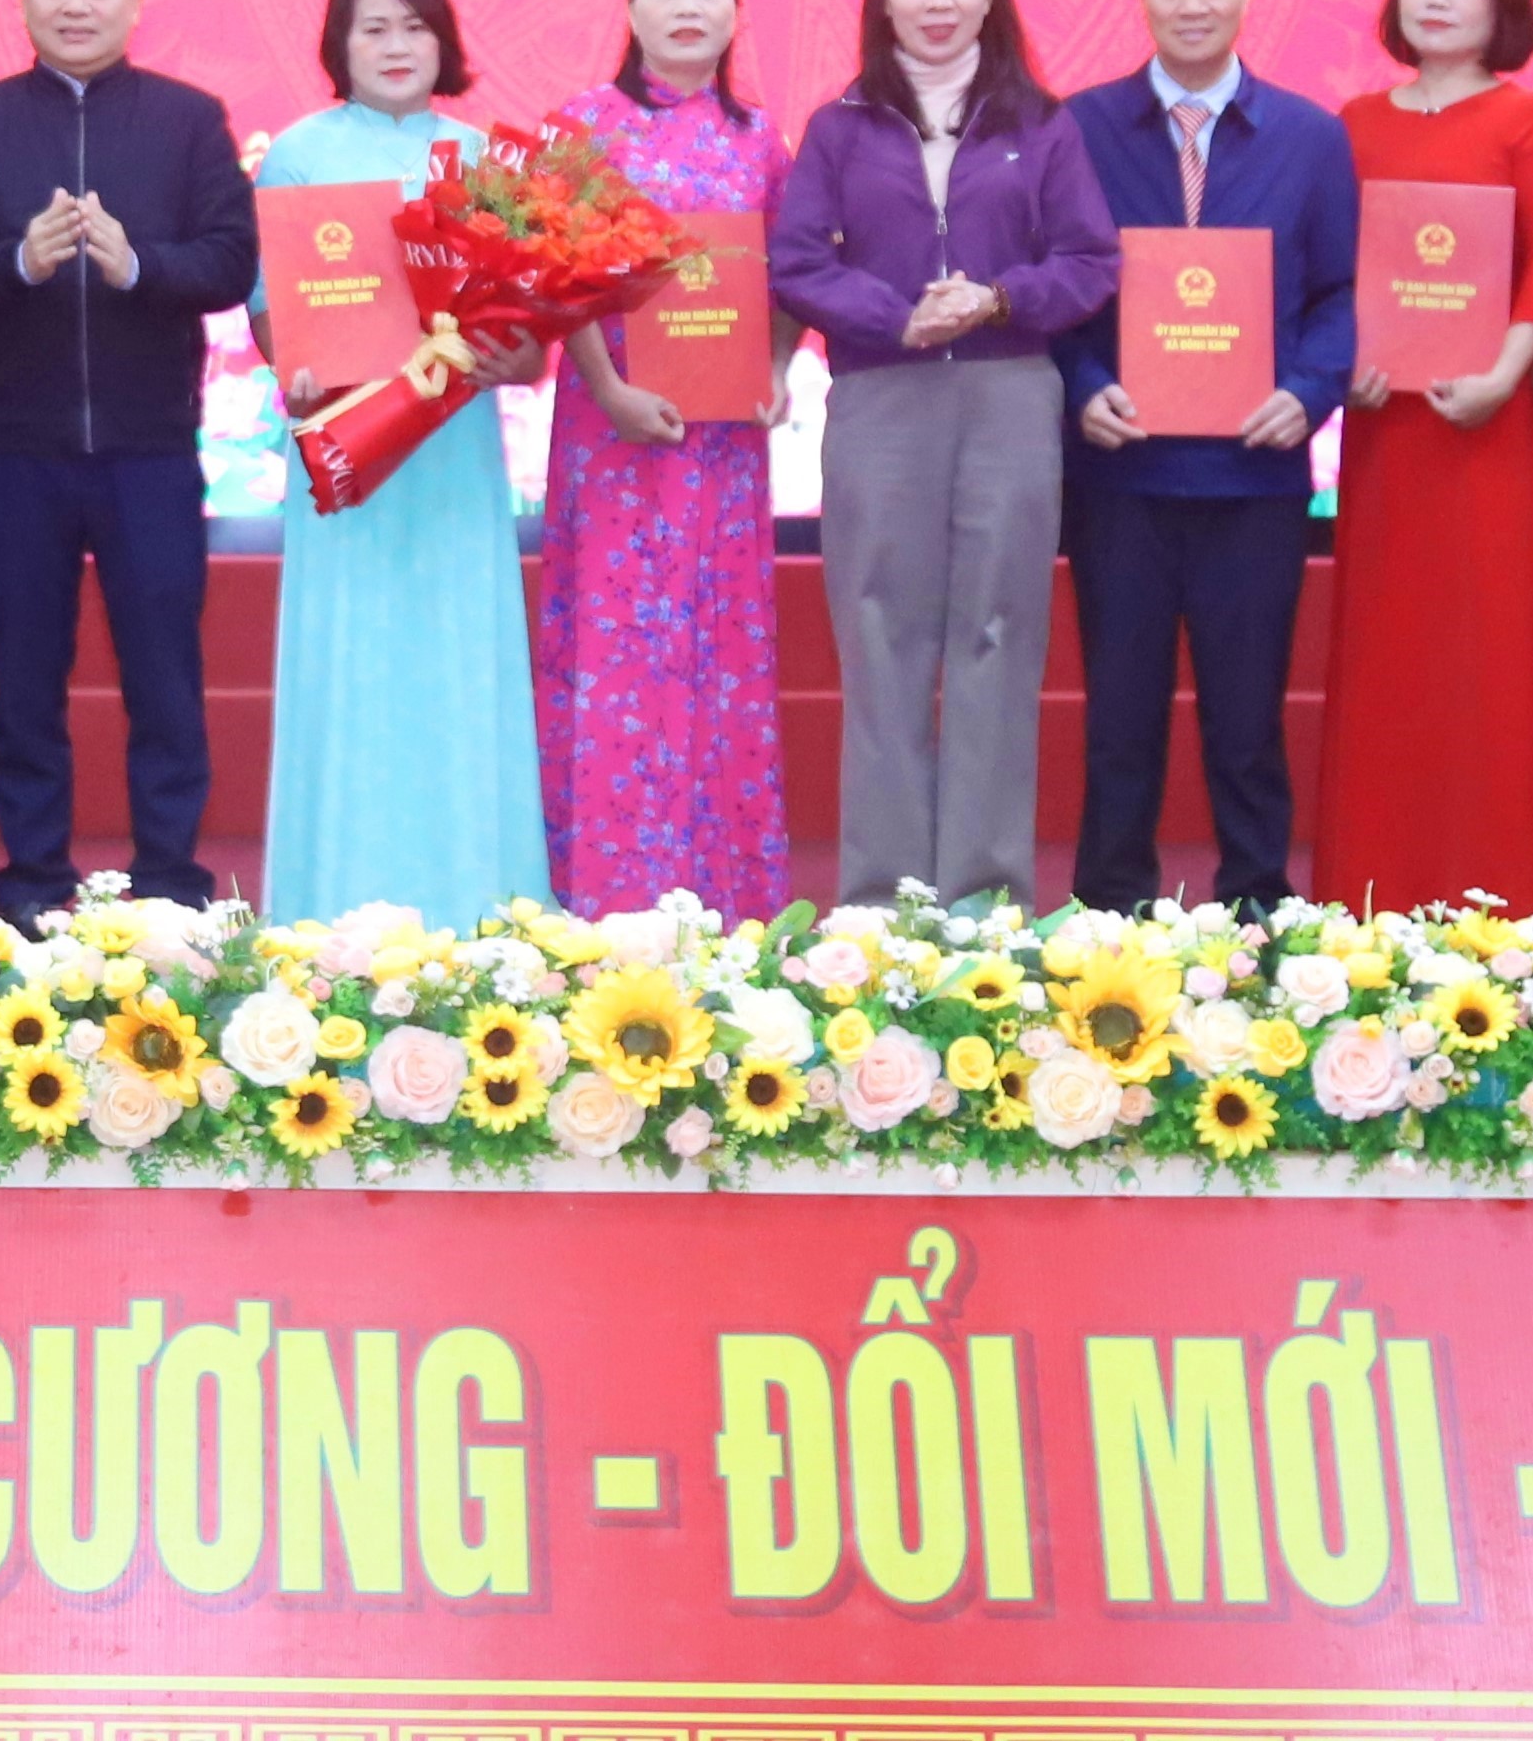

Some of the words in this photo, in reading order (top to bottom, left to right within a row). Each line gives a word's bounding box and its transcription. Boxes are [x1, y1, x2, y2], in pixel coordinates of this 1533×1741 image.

[593, 1454, 658, 1509] -
[716, 1225, 1037, 1604] ĐỔI
[1084, 1277, 1460, 1608] MỚI
